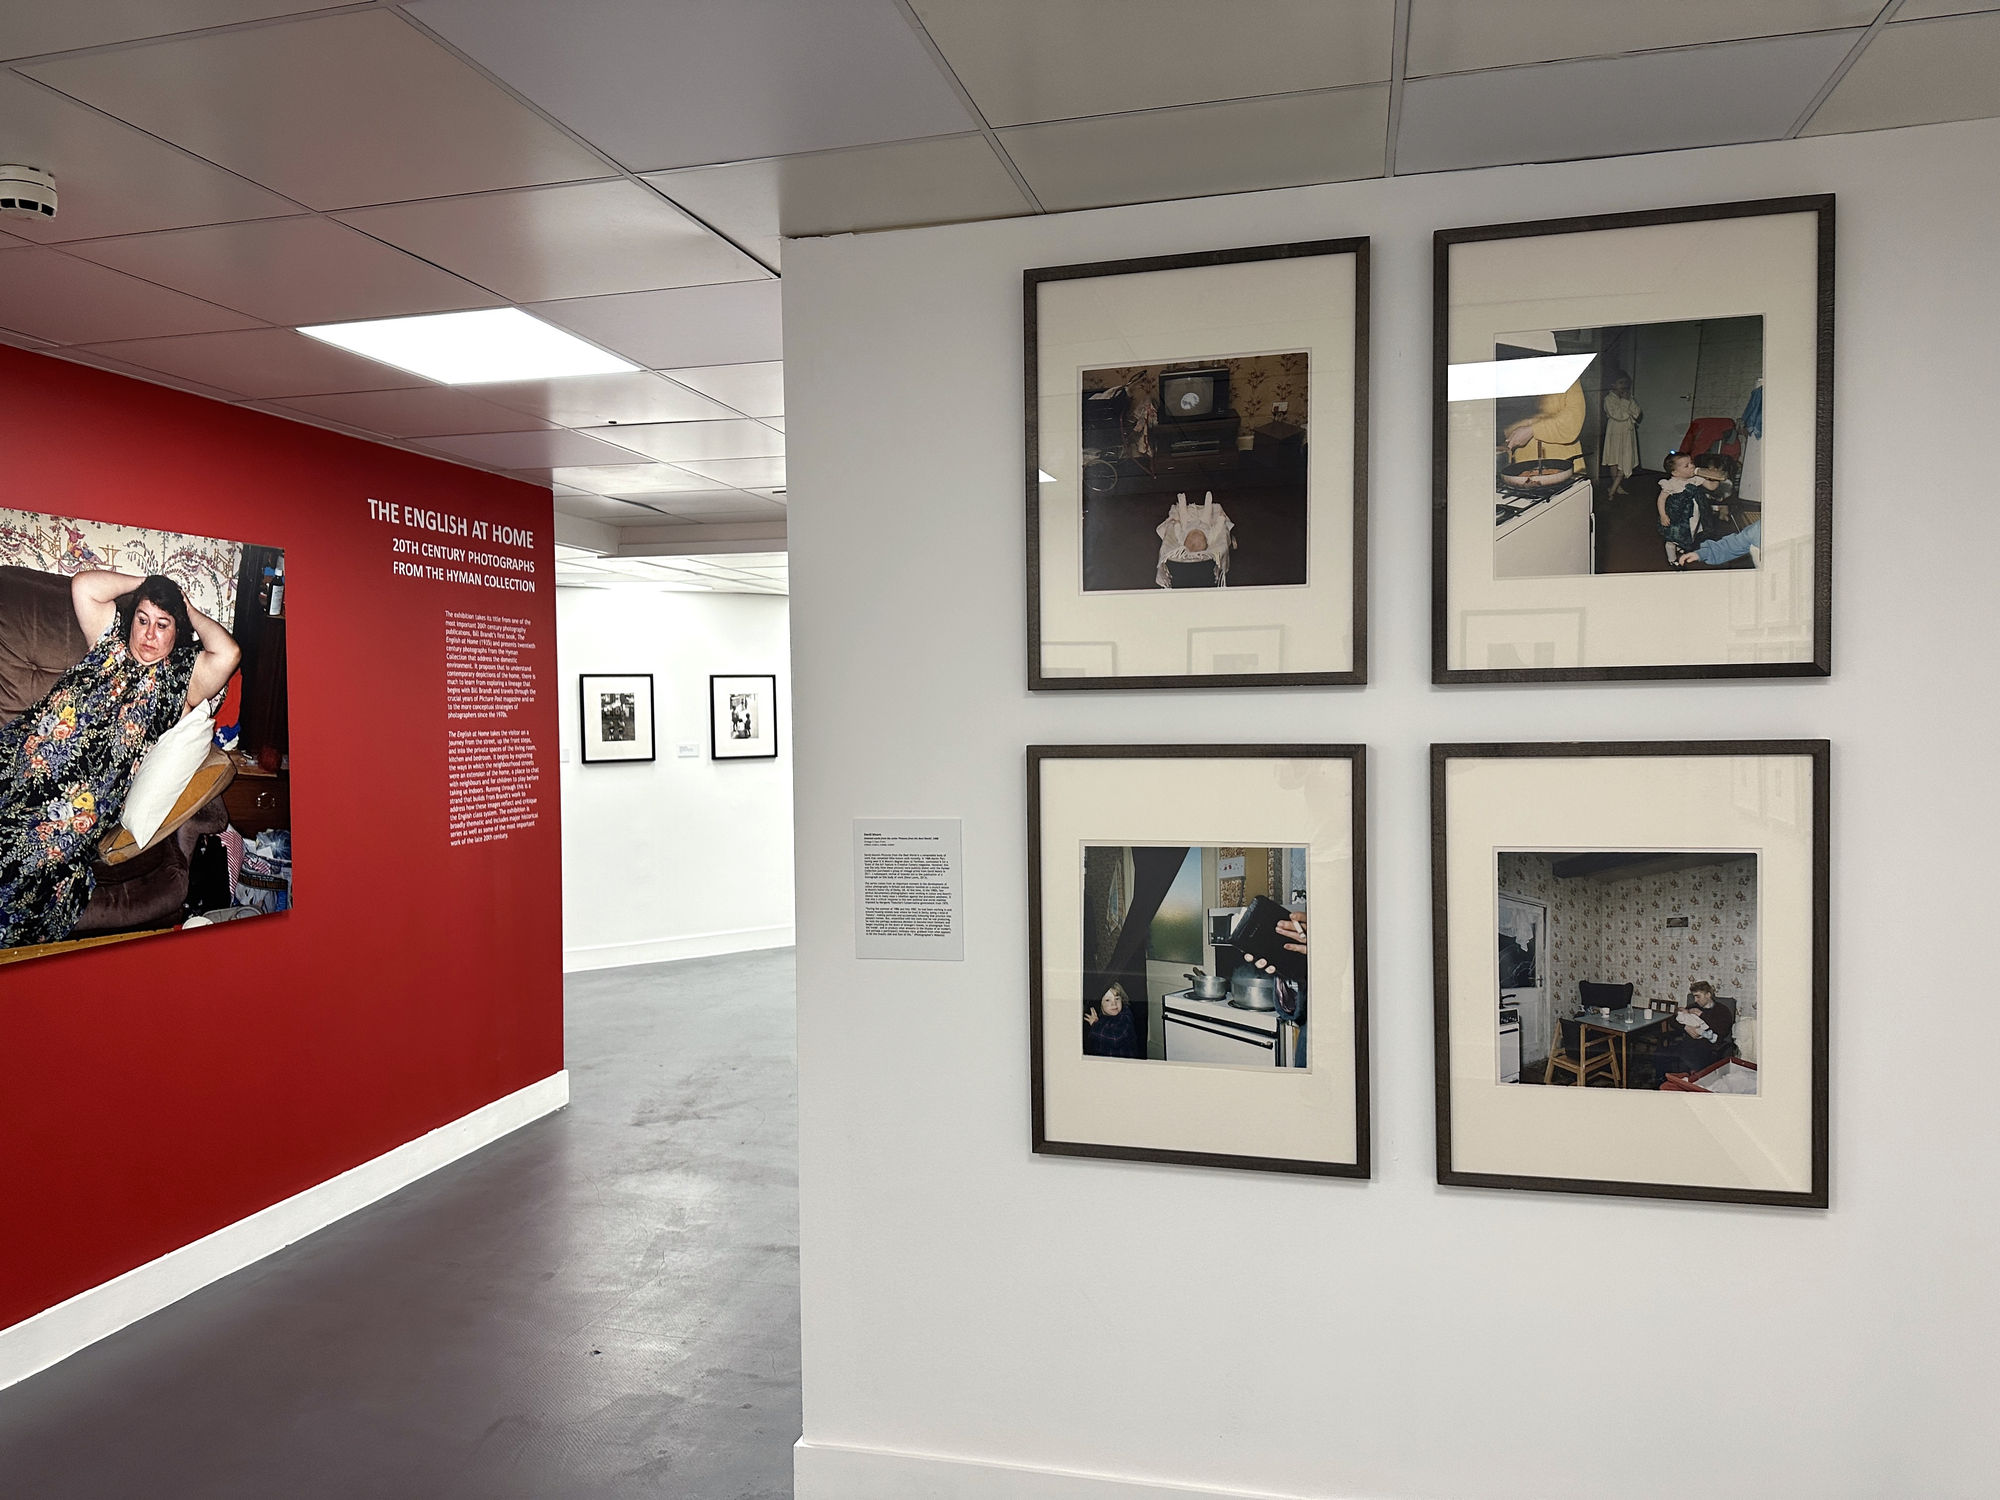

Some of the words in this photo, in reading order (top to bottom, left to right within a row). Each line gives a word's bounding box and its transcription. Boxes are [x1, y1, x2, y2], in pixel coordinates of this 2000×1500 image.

[367, 498, 400, 524] THE
[404, 505, 468, 537] ENGLISH
[471, 520, 489, 540] AT
[492, 524, 534, 549] HOME
[392, 538, 419, 555] 20TH
[421, 543, 466, 562] CENTURY
[468, 551, 535, 573] PHOTOGRAPHS
[393, 561, 424, 578] FROM
[425, 566, 444, 580] THE
[446, 569, 482, 585] HYMAN
[484, 574, 535, 593] COLLECTION
[456, 621, 476, 630] important
[487, 623, 501, 632] century
[502, 625, 525, 634] photography
[446, 637, 460, 645] English
[446, 645, 461, 654] century
[462, 646, 486, 655] photographs
[446, 671, 474, 679] contemporary
[459, 780, 480, 788] neighbours
[449, 789, 462, 798] taking
[486, 786, 500, 794] Running
[502, 785, 515, 793] through
[487, 802, 500, 810] images
[458, 813, 471, 822] English
[450, 822, 465, 831] broadly
[509, 815, 519, 823] major
[516, 821, 534, 830] important
